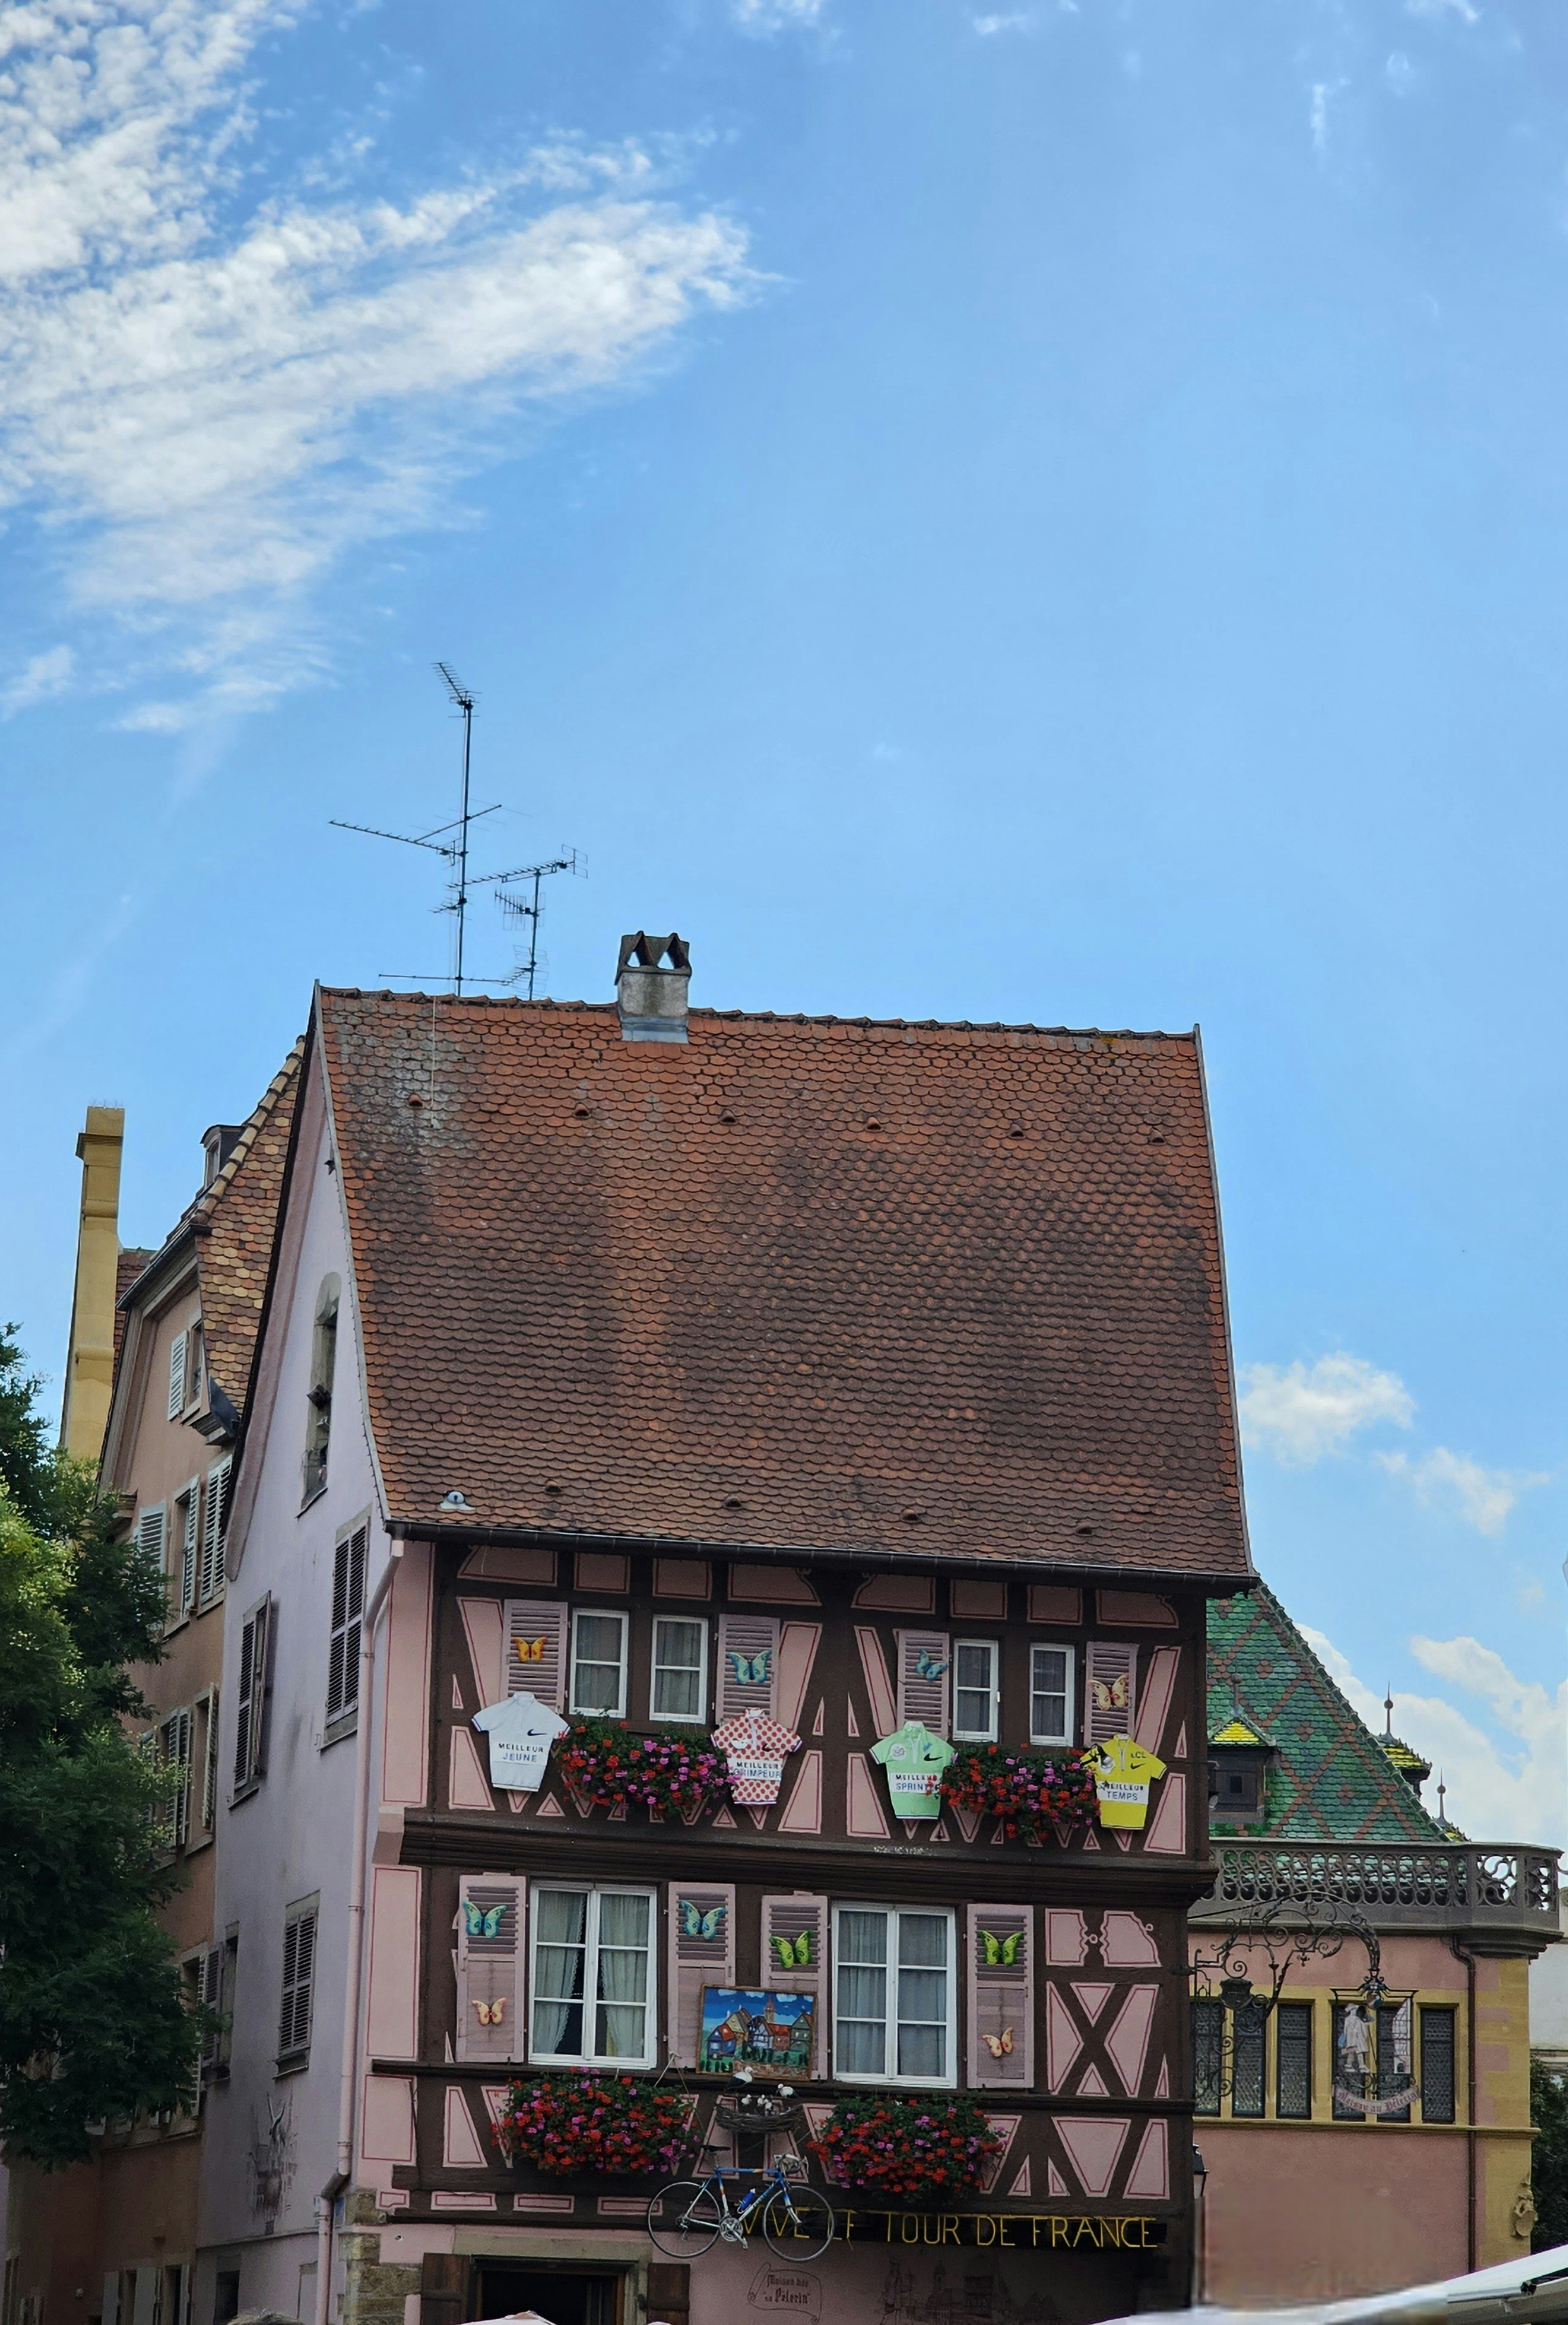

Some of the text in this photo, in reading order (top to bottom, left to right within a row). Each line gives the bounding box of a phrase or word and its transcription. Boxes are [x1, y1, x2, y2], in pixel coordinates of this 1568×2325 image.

[498, 1743, 544, 1753] MEILLEUR
[503, 1752, 538, 1762] JEUNE
[1107, 1791, 1138, 1801] TEMPS
[743, 2206, 810, 2239] VVE
[883, 2210, 961, 2245] TOUR
[977, 2213, 1016, 2246] DE
[1033, 2215, 1158, 2248] FRANCE
